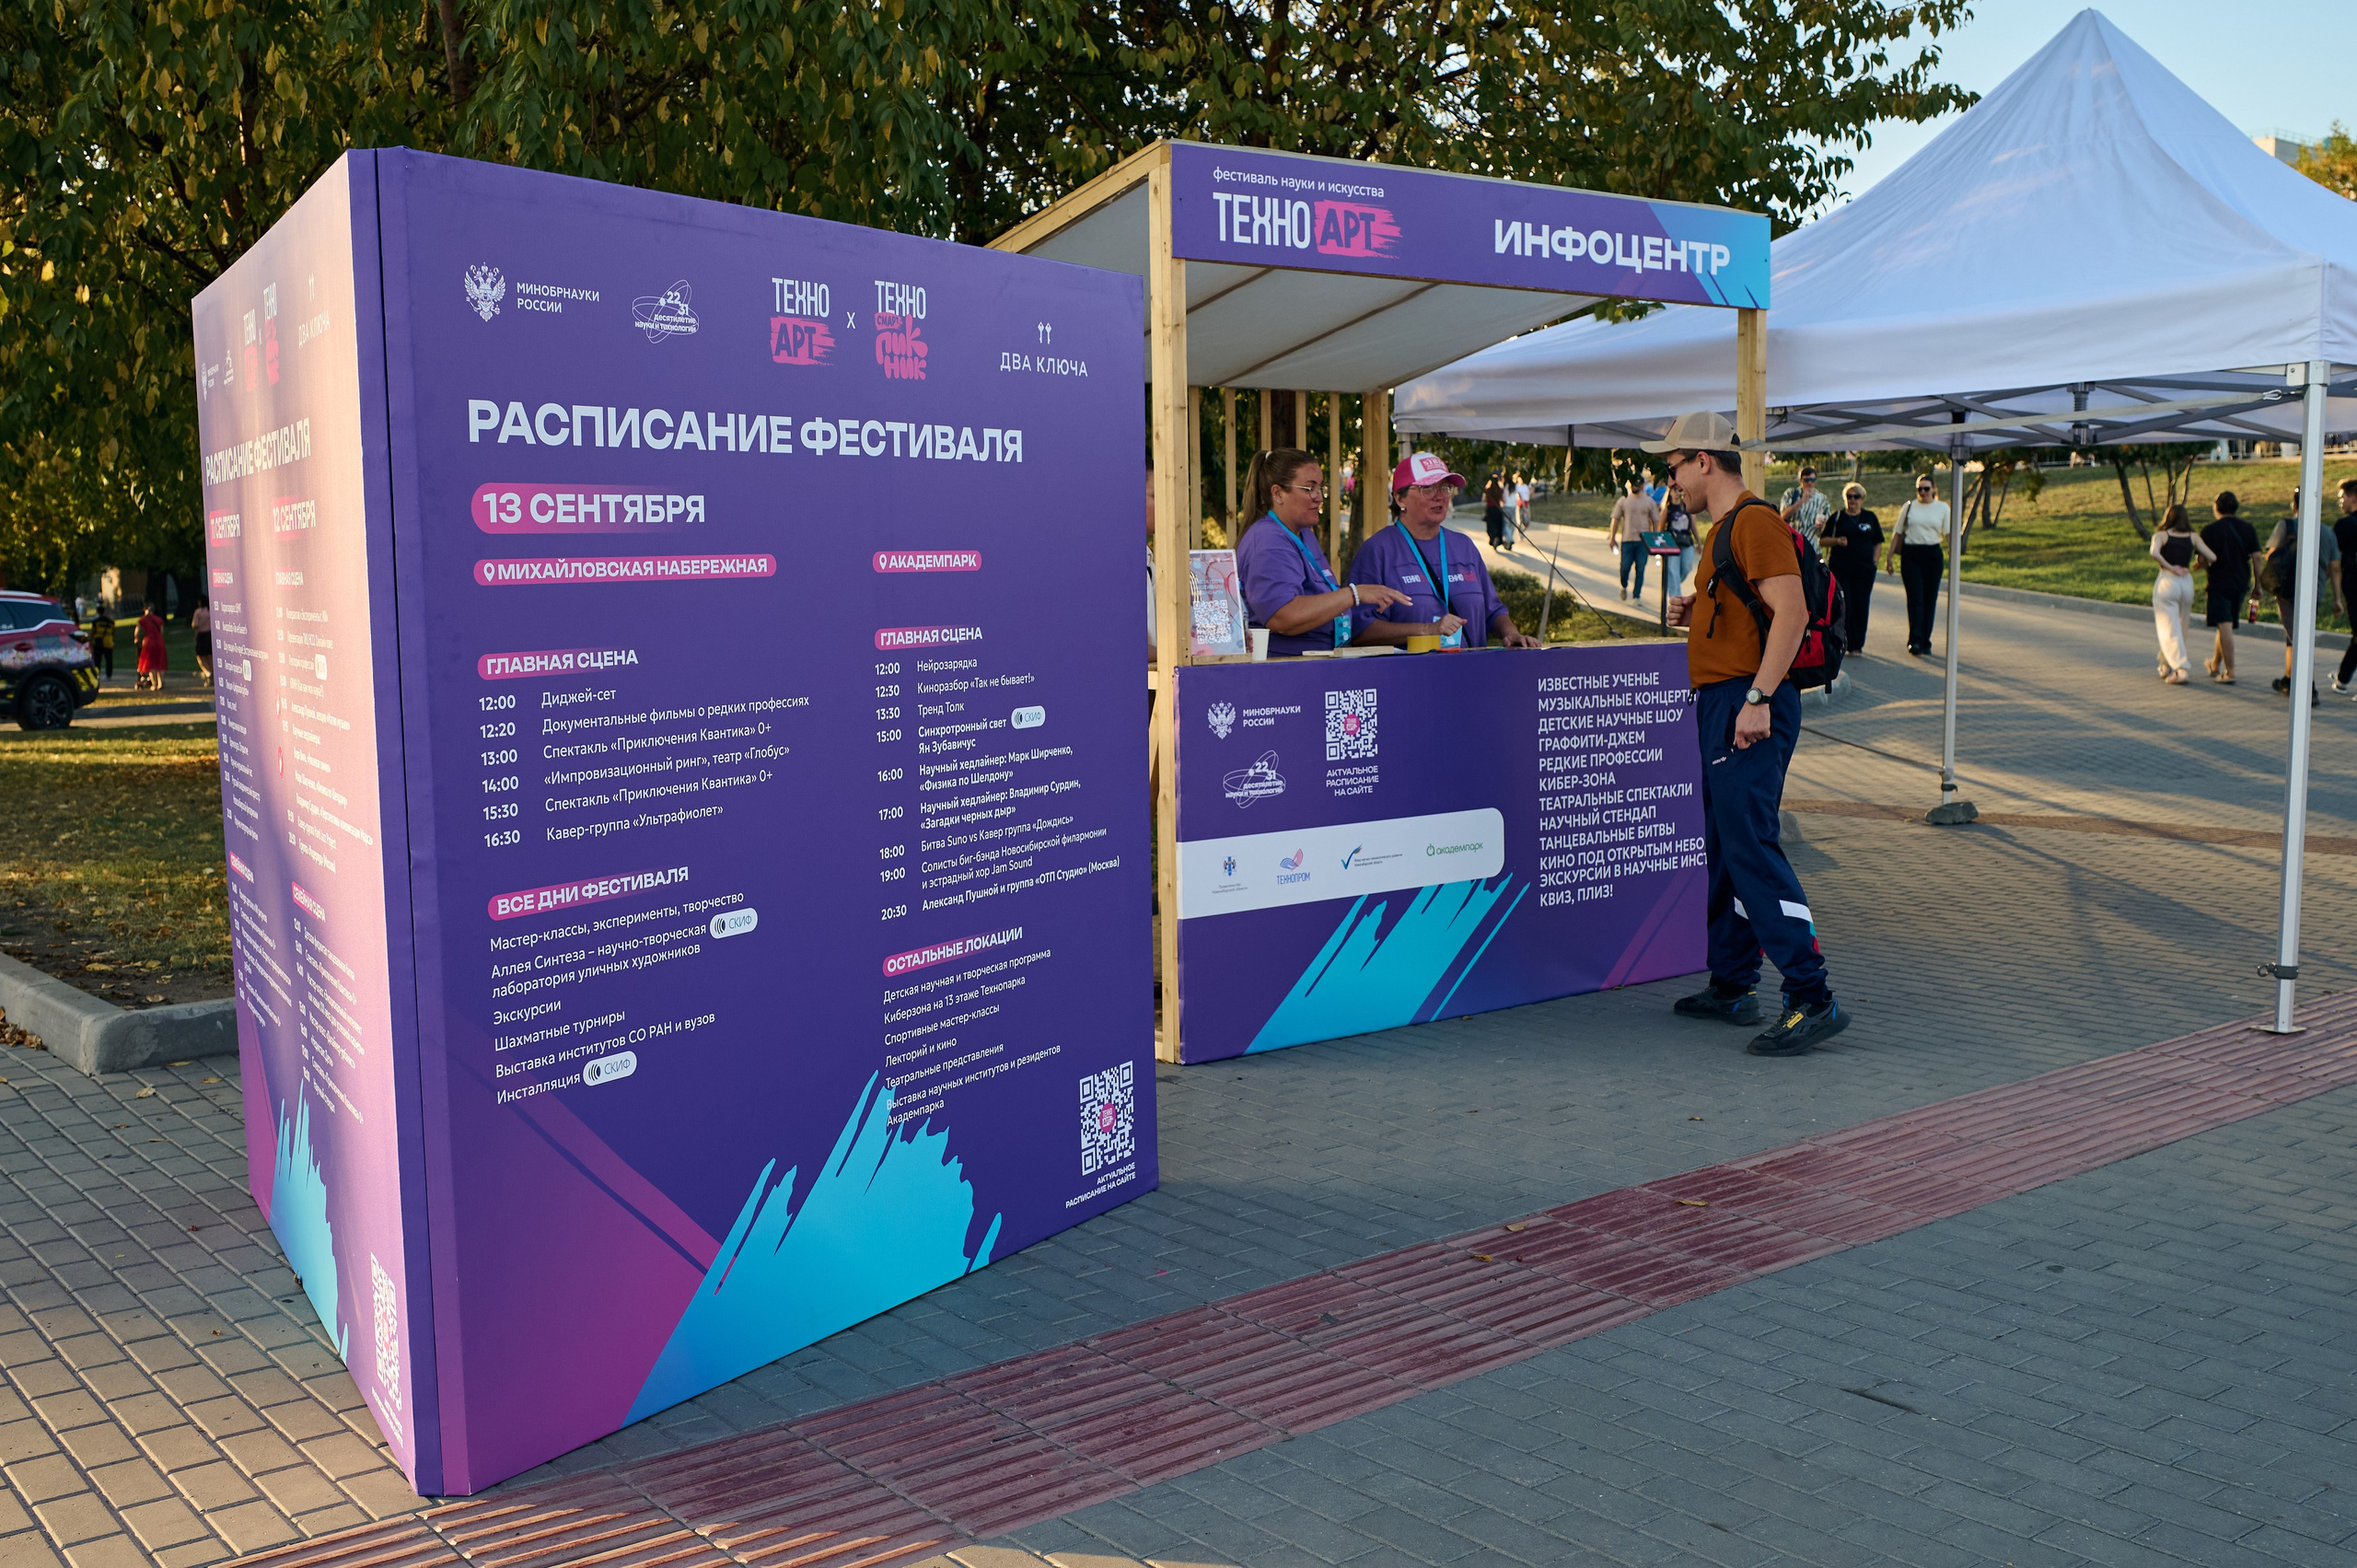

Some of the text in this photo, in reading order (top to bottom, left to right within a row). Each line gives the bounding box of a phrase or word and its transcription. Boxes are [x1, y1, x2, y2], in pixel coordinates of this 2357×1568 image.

[1213, 166, 1385, 198] фестиваль науки и искусства
[1213, 192, 1376, 250] ТЕХНО АРТ
[1494, 219, 1731, 275] ИНФОЦЕНТР
[517, 282, 600, 302] МИНОБРНАУКИ
[772, 277, 830, 318] ТЕХНО
[874, 280, 927, 319] ТЕХНО
[517, 297, 563, 314] РОССИИ
[298, 309, 331, 350] ДВА КЛЮЧА
[634, 320, 654, 331] науки
[660, 321, 697, 332] технологий
[654, 314, 696, 325] десятилетие
[774, 322, 817, 359] АРТ
[1000, 352, 1088, 377] ДВА КЛЮЧА
[469, 399, 1023, 463] РАСПИСАНИЕ ФЕСТИВАЛЯ
[205, 417, 311, 486] РАСПИСАНИЕ ФЕСТИВАЛЯ
[273, 500, 316, 532] 12 СЕНТЯБРЯ
[482, 492, 705, 524] 13 СЕНТЯБРЯ
[215, 514, 240, 539] СЕНТЯБРЯ
[497, 558, 768, 580] МИХАЙЛОВСКАЯ НАБЕРЕЖНАЯ
[889, 554, 977, 570] АКАДЕМПАРК
[1448, 574, 1464, 583] ЕХНО
[880, 627, 982, 645] ГЛАВНАЯ СЦЕНА
[487, 649, 639, 675] ГЛАВНАЯ СЦЕНА
[875, 662, 900, 675] 12:00
[917, 659, 977, 673] Нейрозарядка
[876, 684, 900, 698] 12:30
[918, 672, 1035, 694] Киноразбор «Так не бывает!»
[1538, 672, 1659, 691] ИЗВЕСТНЫЕ УЧЕНЫЕ
[479, 695, 516, 711] 12:00
[541, 688, 616, 709] Диджей-сет
[918, 702, 964, 718] Тренд Толк
[1538, 692, 1632, 712] МУЗЫКАЛЬНЫЕ
[542, 697, 809, 736] Документальные фильмы о редких профессиях
[876, 707, 900, 720] 13:30
[1243, 705, 1301, 717] МИНОБРНАУКИ
[1243, 717, 1274, 727] РОССИИ
[1538, 708, 1683, 735] ДЕТСКИЕ НАУЧНЫЕ ШОУ
[480, 722, 516, 738] 12:20
[877, 729, 901, 742] 15:00
[918, 712, 1041, 738] Синхротронный свет СКИФ
[543, 743, 608, 759] Спектакль
[610, 733, 697, 753] «Приключения
[701, 726, 756, 741] Квантика»
[919, 738, 976, 755] Ян Зубавичус
[1539, 730, 1644, 751] ГРАФФИТИ-ДЖЕМ
[481, 749, 517, 766] 13:00
[544, 744, 790, 784] «Импровизационный ринг», театр «Глобус»
[920, 746, 1073, 777] Научный хедлайнер: Марк Ширченко,
[1539, 748, 1663, 773] РЕДКИЕ ПРОФЕССИИ
[877, 768, 903, 782] 16:00
[920, 771, 1014, 791] «Физика по Шелдону»
[1326, 765, 1378, 777] АКТУАЛЬНОЕ
[1326, 775, 1379, 787] РАСПИСАНИЕ
[1539, 772, 1616, 792] КИБЕР-ЗОНА
[482, 776, 518, 793] 14:00
[1334, 784, 1374, 796] НА САЙТЕ
[1538, 783, 1692, 811] ТЕАТРАЛЬНЫЕ СПЕКТАКЛИ
[547, 807, 723, 841] Кавер-группа «Ультрафиолет»
[1540, 806, 1656, 830] НАУЧНЫЙ СТЕНДАП
[484, 830, 520, 847] 16:30
[1539, 822, 1675, 851] ТАНЦЕВАЛЬНЫЕ БИТВЫ
[1435, 842, 1483, 856] академпарк
[1540, 837, 1704, 870] КИНО ПОД ОТКРЫТЫМ НЕБО
[923, 855, 1120, 911] Александ Пушной и группа «ОТП Студио» (Москва)
[1276, 872, 1311, 885] ТЕХНОПРОМ
[497, 866, 689, 915] ВСЕ ДНИ ФЕСТИВАЛЯ
[1540, 884, 1613, 907] КВИЗ, ПЛИЗ!
[491, 893, 744, 952] Мастер-классы, эксперименты, творчество
[881, 904, 907, 921] 20:30
[491, 914, 752, 979] Аллея Синтеза научно-творческая СКИФ
[888, 926, 1022, 972] ОСТАЛЬНЫЕ ЛОКАЦИИ
[883, 949, 1051, 1005] Детская научная и творческая программа
[493, 1001, 561, 1025] Экскурсии
[495, 1011, 625, 1051] Шахматные турниры
[885, 1038, 957, 1067] Лекторий и кино
[497, 1059, 631, 1104] Инсталляция СКИФ
